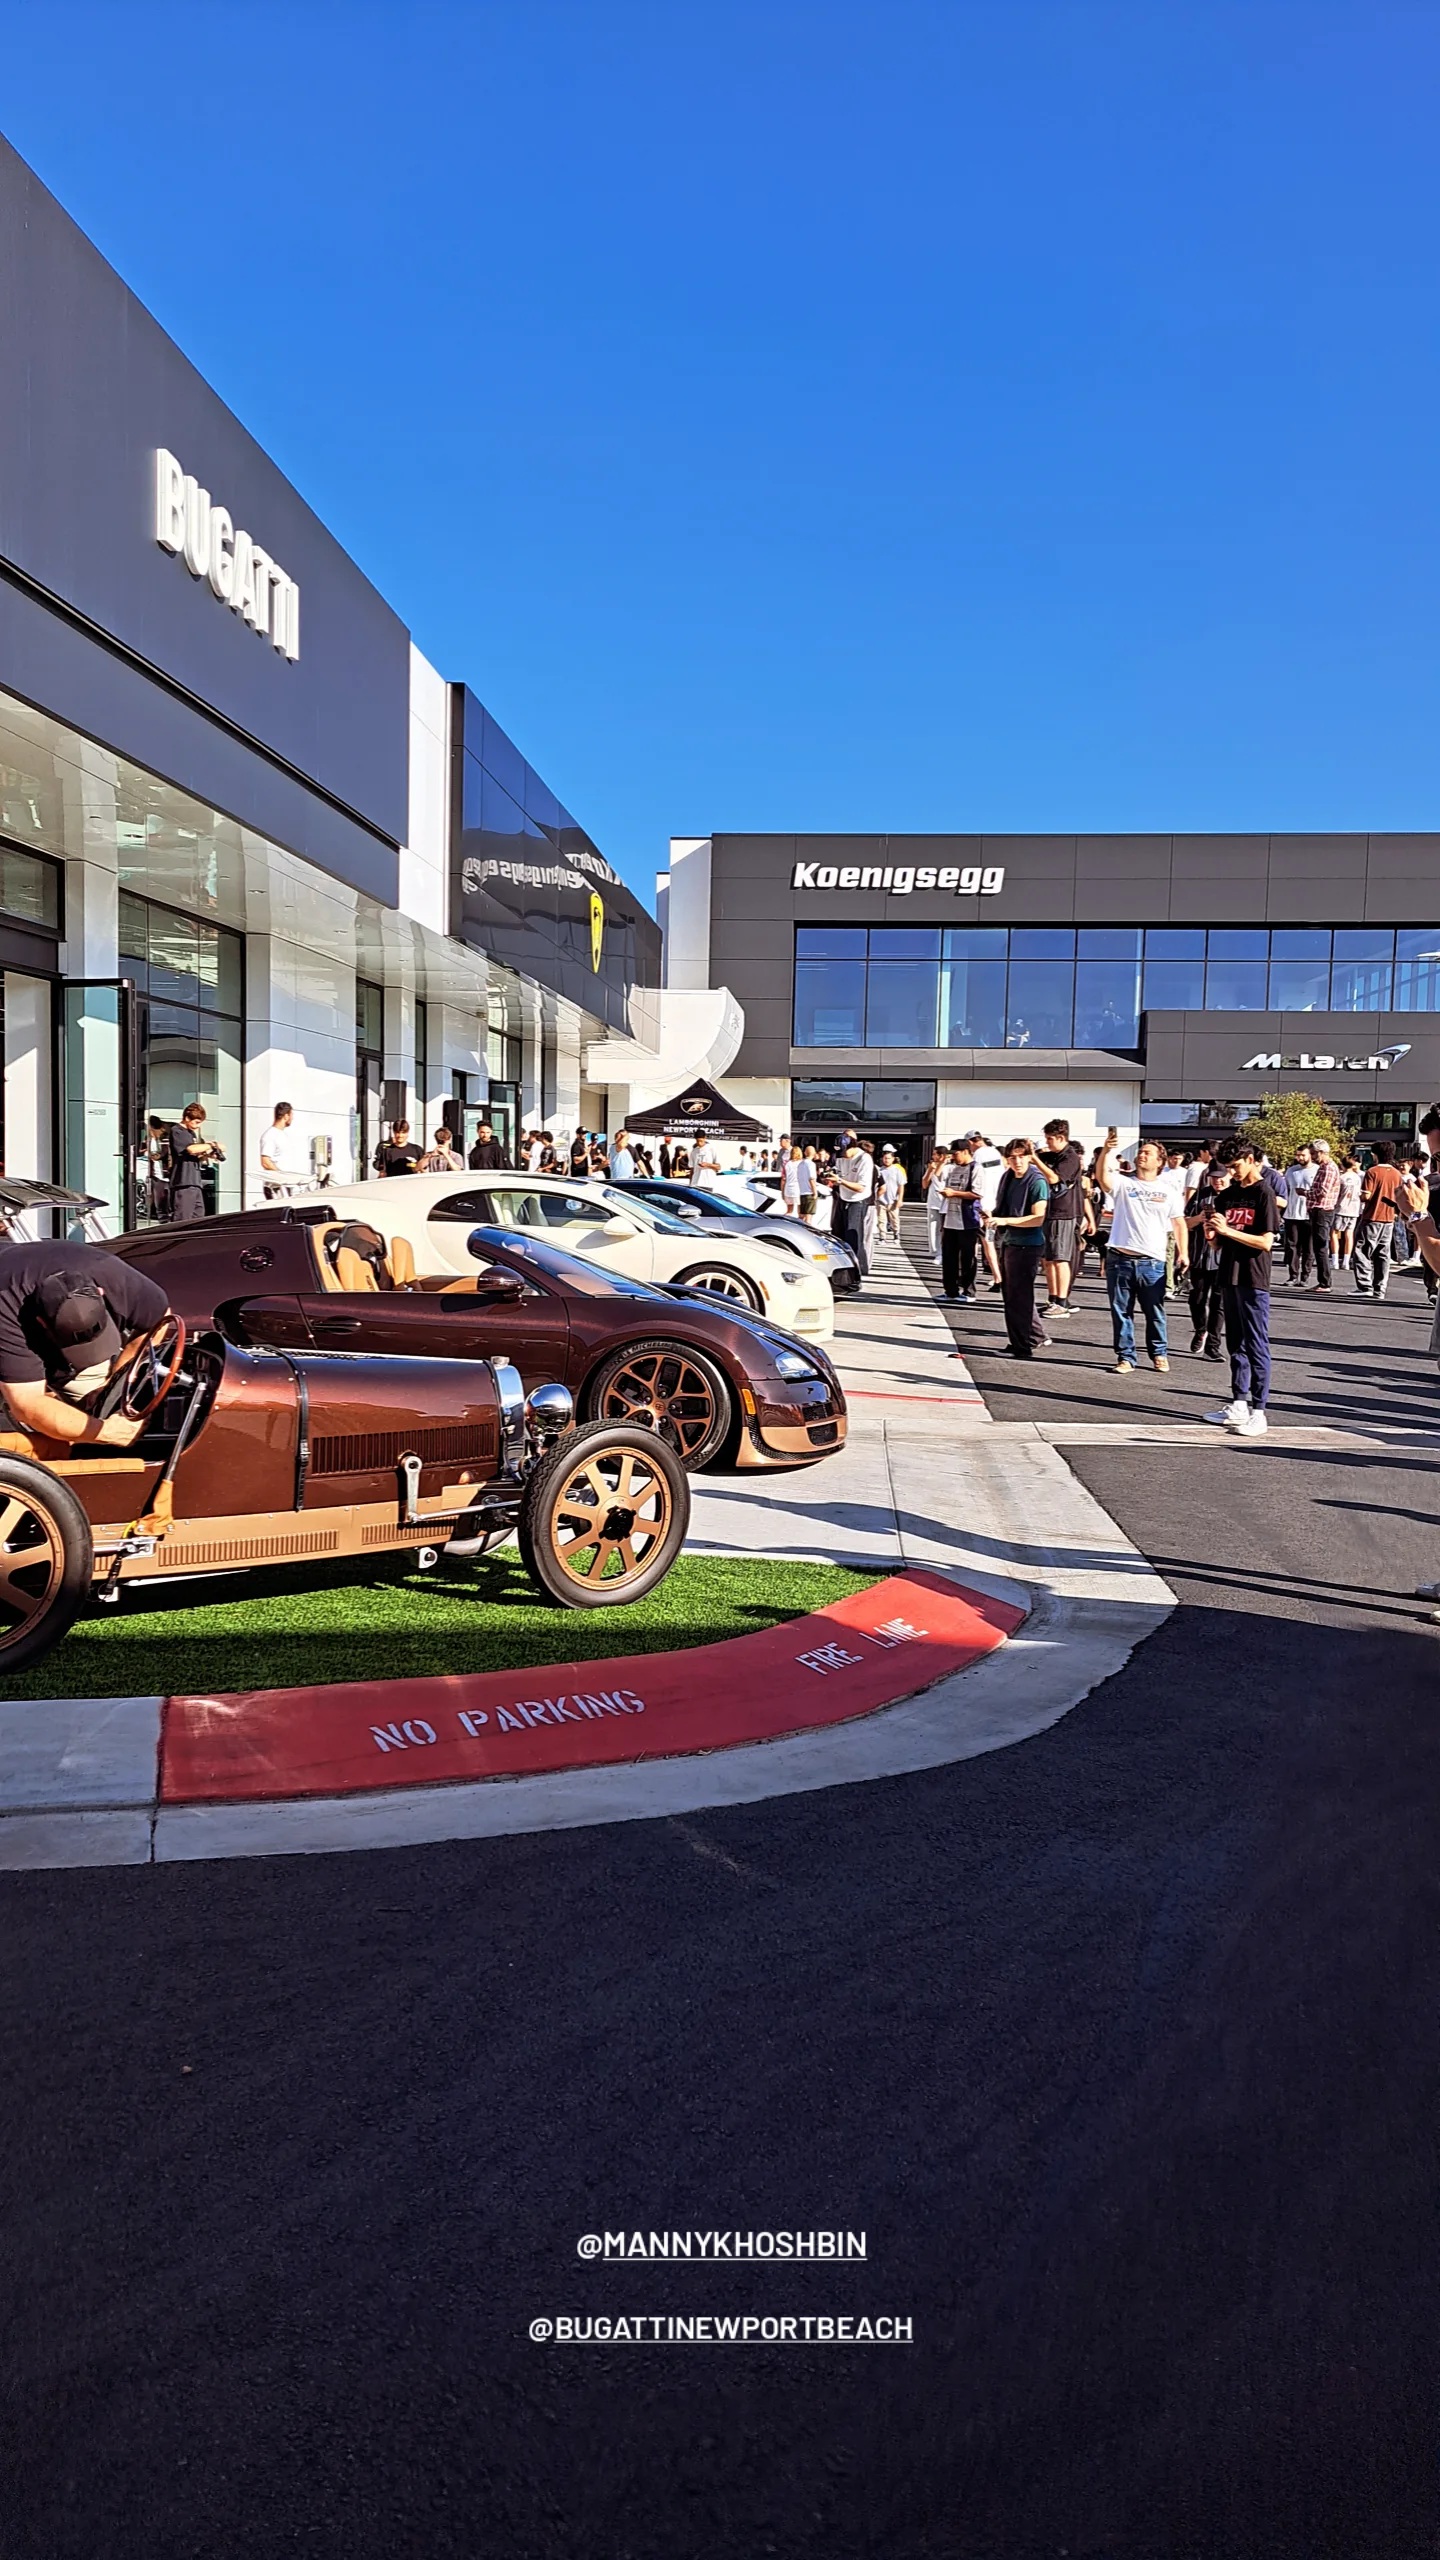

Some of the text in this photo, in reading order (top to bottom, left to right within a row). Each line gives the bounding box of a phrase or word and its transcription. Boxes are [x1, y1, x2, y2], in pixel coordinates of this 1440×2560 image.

[156, 448, 300, 661] BUGATTI
[793, 862, 1005, 894] Koenigsegg
[1240, 1053, 1390, 1070] McLaren
[663, 1126, 698, 1134] NEWPORT
[668, 1119, 720, 1127] LAMBORGHINI
[794, 1617, 931, 1677] FIRE LANE
[369, 1689, 646, 1753] NO PARKING
